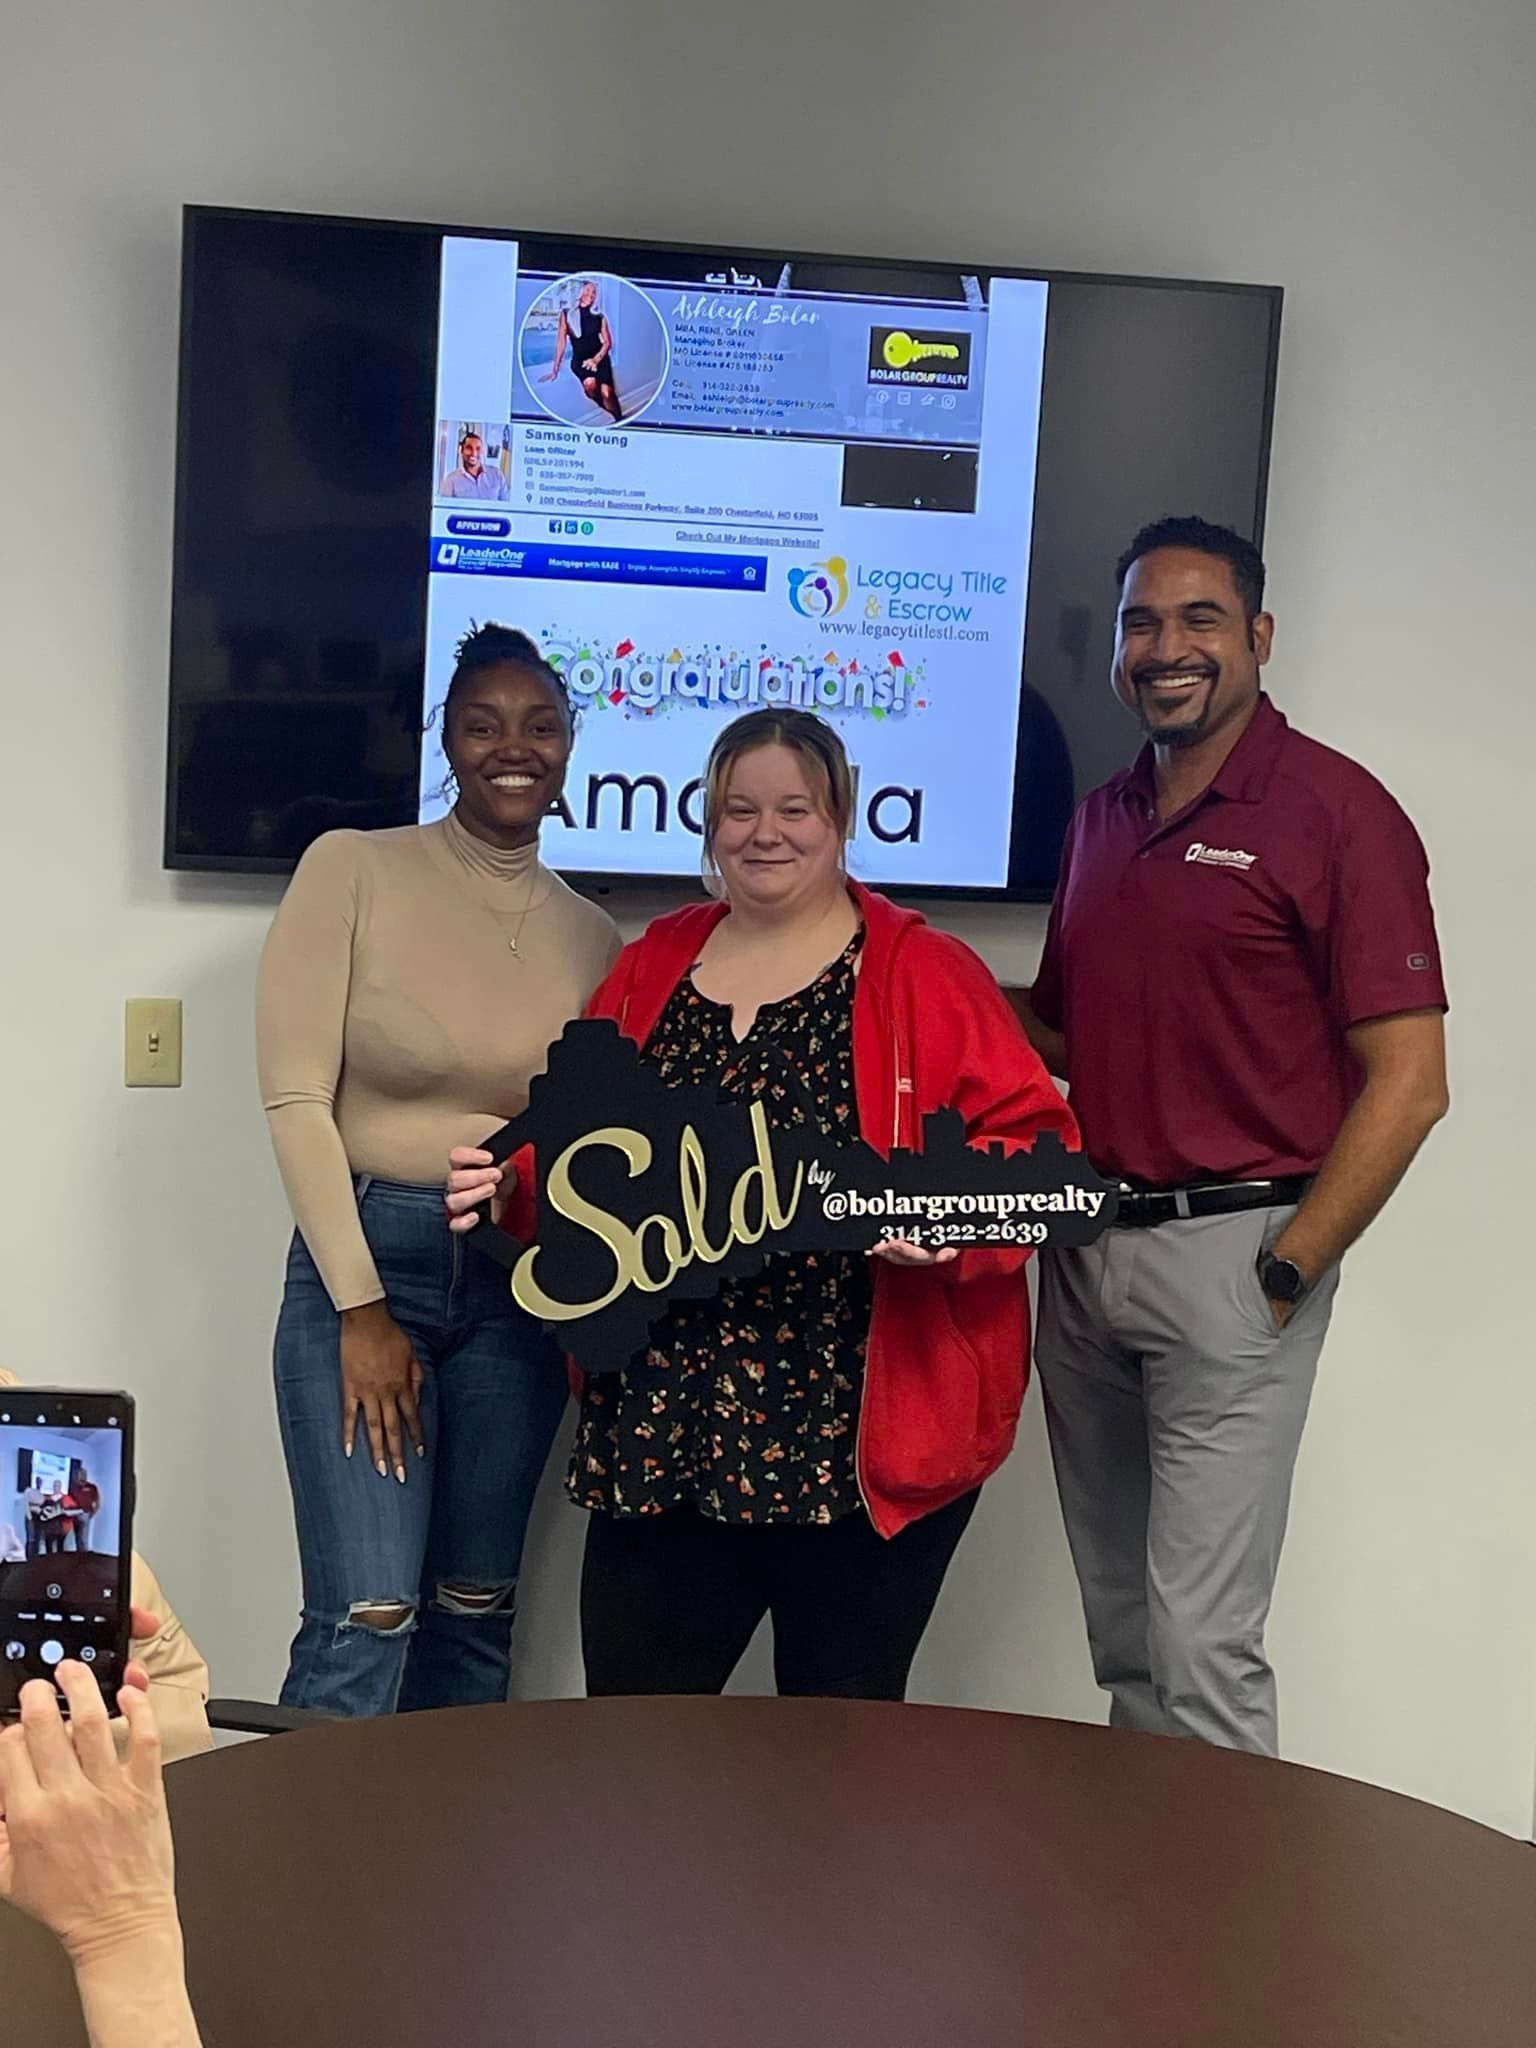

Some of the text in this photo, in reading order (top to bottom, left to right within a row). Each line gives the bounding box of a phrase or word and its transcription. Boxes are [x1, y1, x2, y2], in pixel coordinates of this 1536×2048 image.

[672, 294, 819, 328] Ashleigh Bolar
[674, 335, 716, 348] Managing
[525, 429, 628, 448] Samson Young
[547, 446, 577, 456] Officer
[539, 496, 555, 506] 100
[607, 500, 643, 511] Business
[707, 506, 723, 516] 200
[456, 520, 481, 531] APPLY
[676, 530, 703, 543] Check
[706, 532, 722, 543] Out
[724, 534, 737, 545] My
[460, 546, 524, 559] LeaderOne
[548, 557, 583, 569] Mortgage
[857, 565, 1007, 599] Legacy Title
[864, 594, 972, 622] & Escrow
[820, 621, 989, 642] www.legacytitlestl.com
[807, 1159, 836, 1193] by
[511, 1100, 803, 1321] Sold
[822, 1184, 1106, 1221] @bolargrouprealty
[879, 1220, 1048, 1246] 314-322-2639
